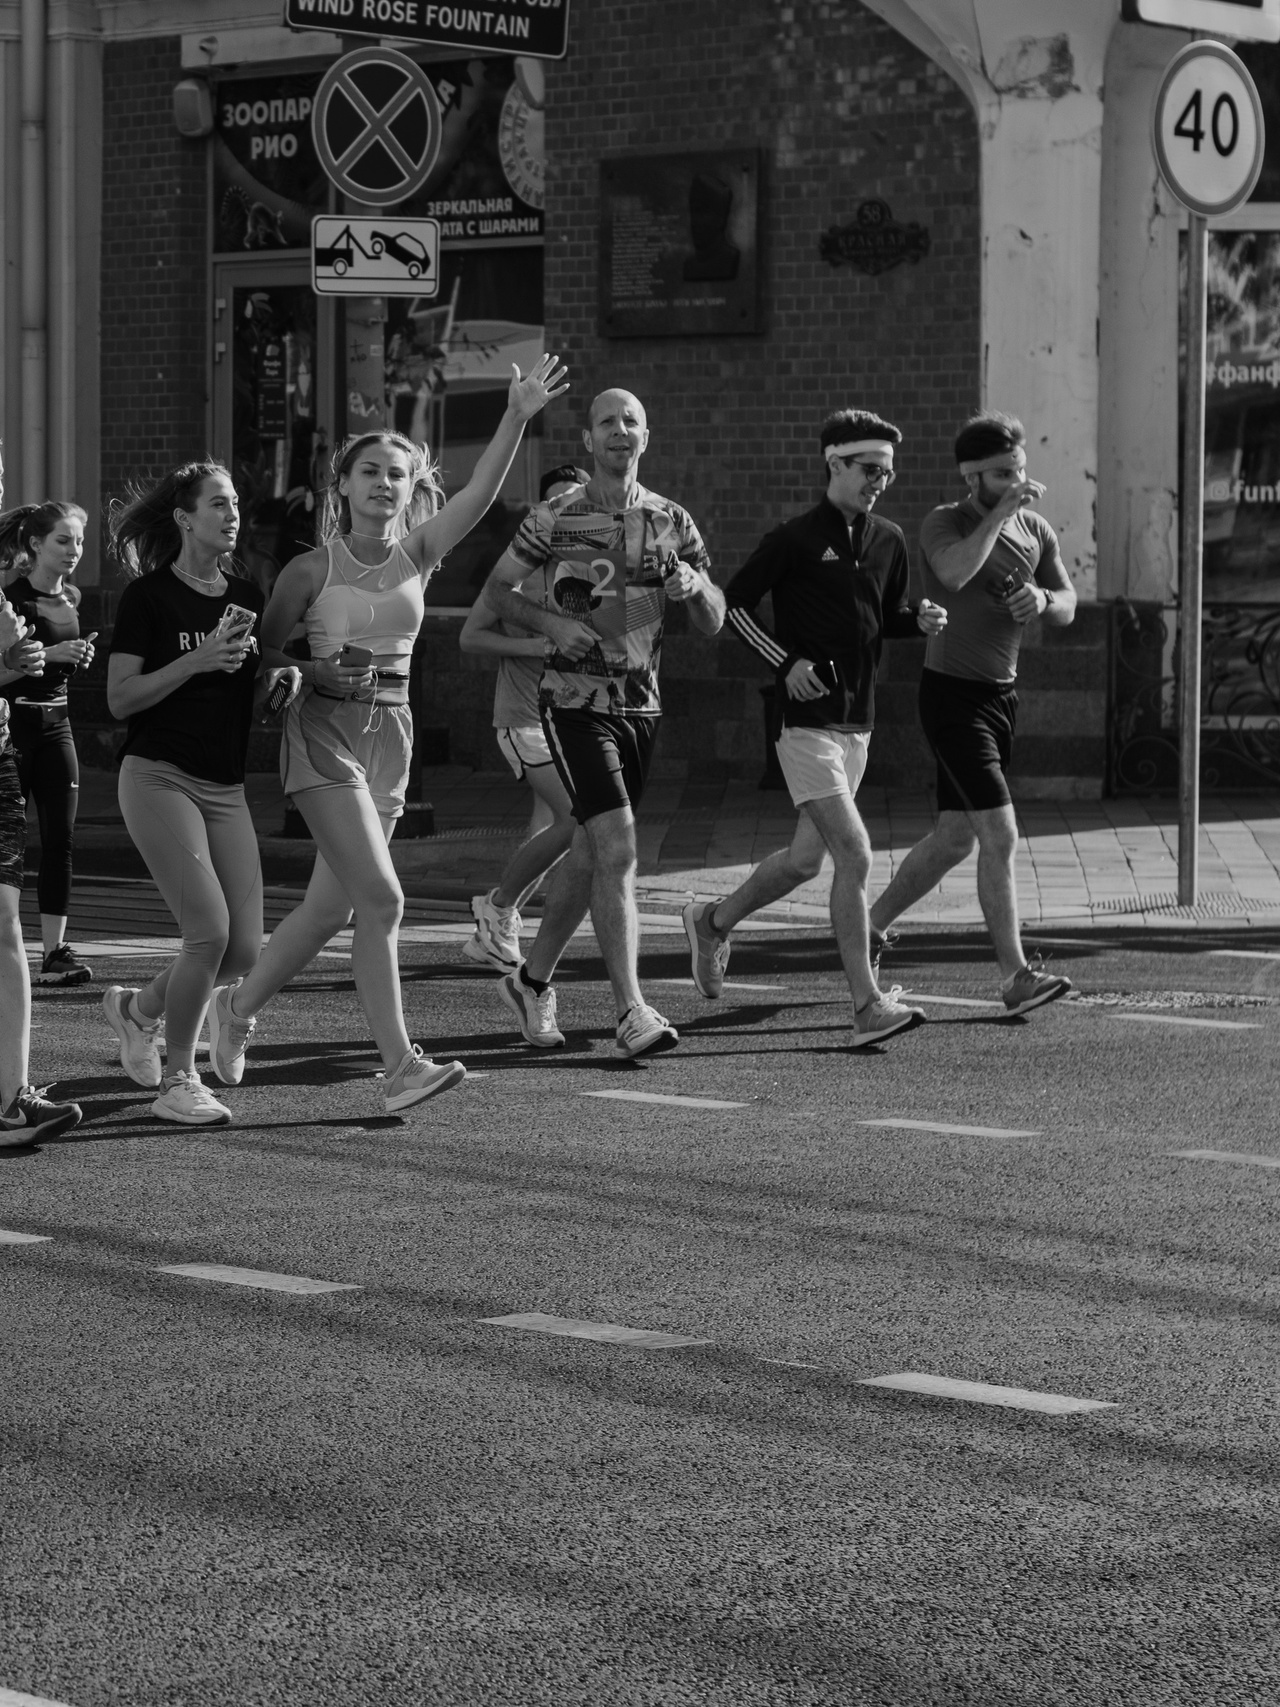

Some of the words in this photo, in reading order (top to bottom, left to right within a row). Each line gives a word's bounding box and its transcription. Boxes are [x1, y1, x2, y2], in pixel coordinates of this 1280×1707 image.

[298, 0, 354, 17] WIND
[362, 0, 418, 25] ROSE
[425, 5, 531, 39] FOUNTAIN
[222, 96, 312, 128] ЗООПАР
[1174, 89, 1239, 157] 40
[250, 133, 299, 160] РИО
[426, 197, 513, 217] ЗЕРКАЛЬНАЯ
[861, 203, 882, 225] 58
[439, 220, 465, 236] АТА
[466, 219, 477, 235] С
[478, 217, 540, 234] ШАРАМИ
[590, 558, 617, 597] 2
